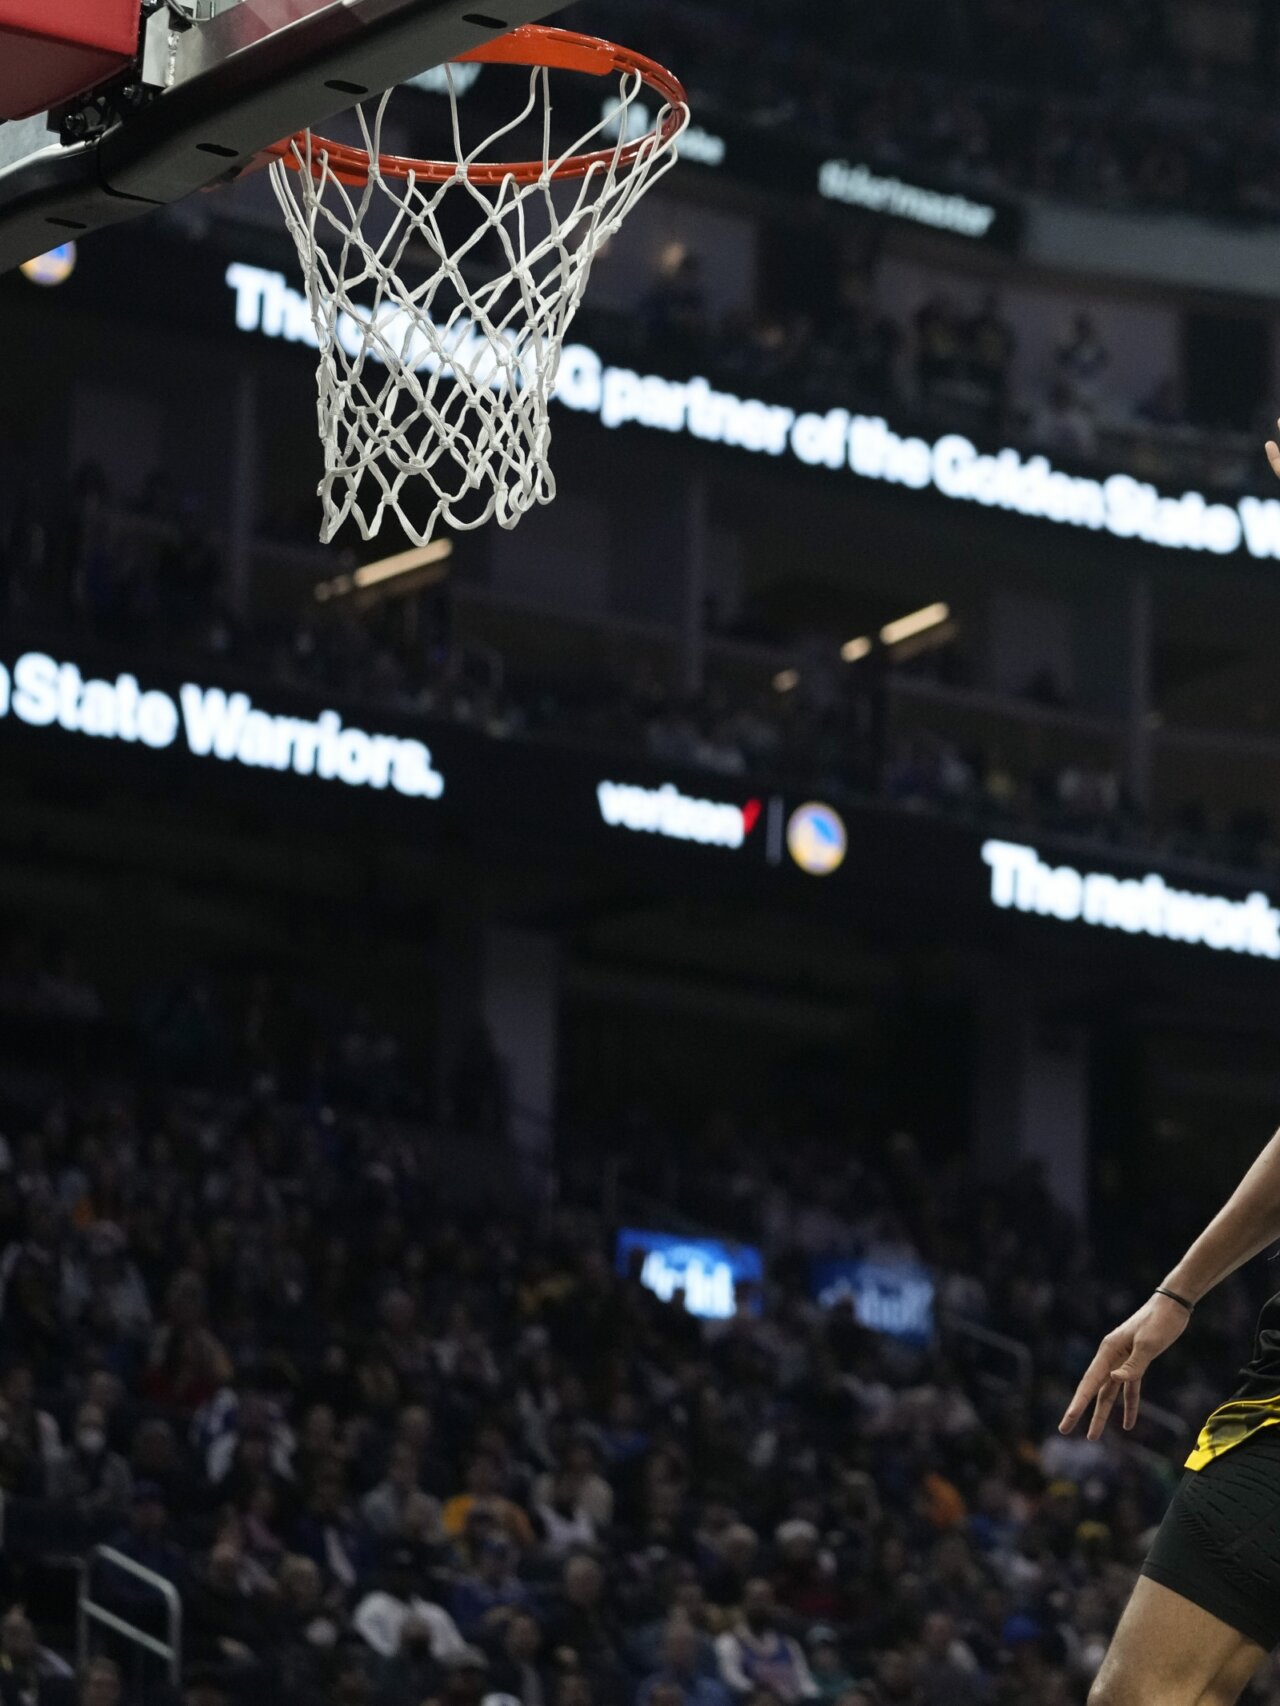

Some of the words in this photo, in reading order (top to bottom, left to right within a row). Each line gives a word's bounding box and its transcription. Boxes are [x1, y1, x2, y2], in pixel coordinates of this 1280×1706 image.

[226, 261, 326, 350] The
[601, 366, 796, 456] partner
[791, 407, 850, 470] of
[848, 413, 932, 491] the
[932, 434, 1104, 531] Golden
[1102, 473, 1241, 555] State
[12, 651, 179, 748] State
[179, 682, 444, 799] Warriors.
[980, 839, 1083, 922] The
